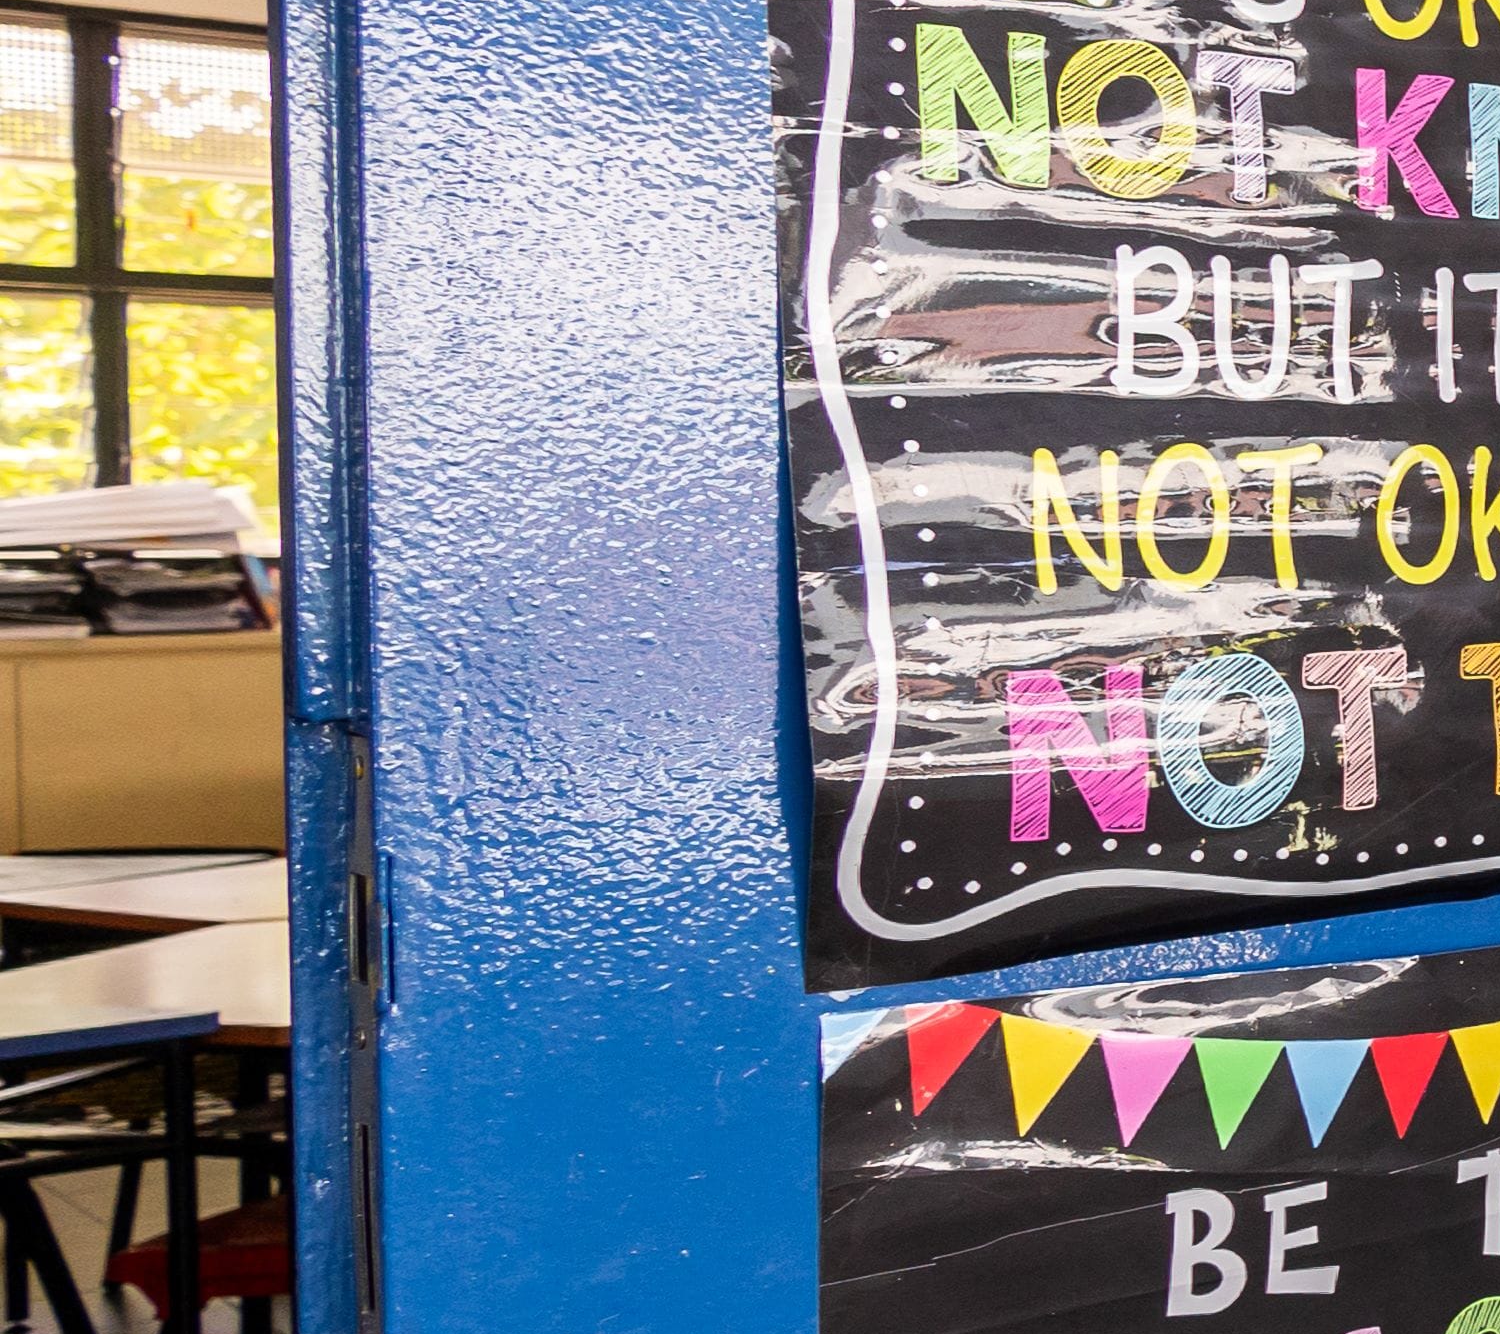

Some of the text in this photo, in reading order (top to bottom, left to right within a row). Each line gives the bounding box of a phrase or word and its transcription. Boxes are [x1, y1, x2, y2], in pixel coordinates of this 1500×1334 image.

[914, 23, 1296, 204] NOT
[1111, 242, 1384, 405] BUT
[1030, 441, 1324, 596] NOT
[1006, 648, 1409, 843] NOT
[1164, 1180, 1342, 1317] BE
